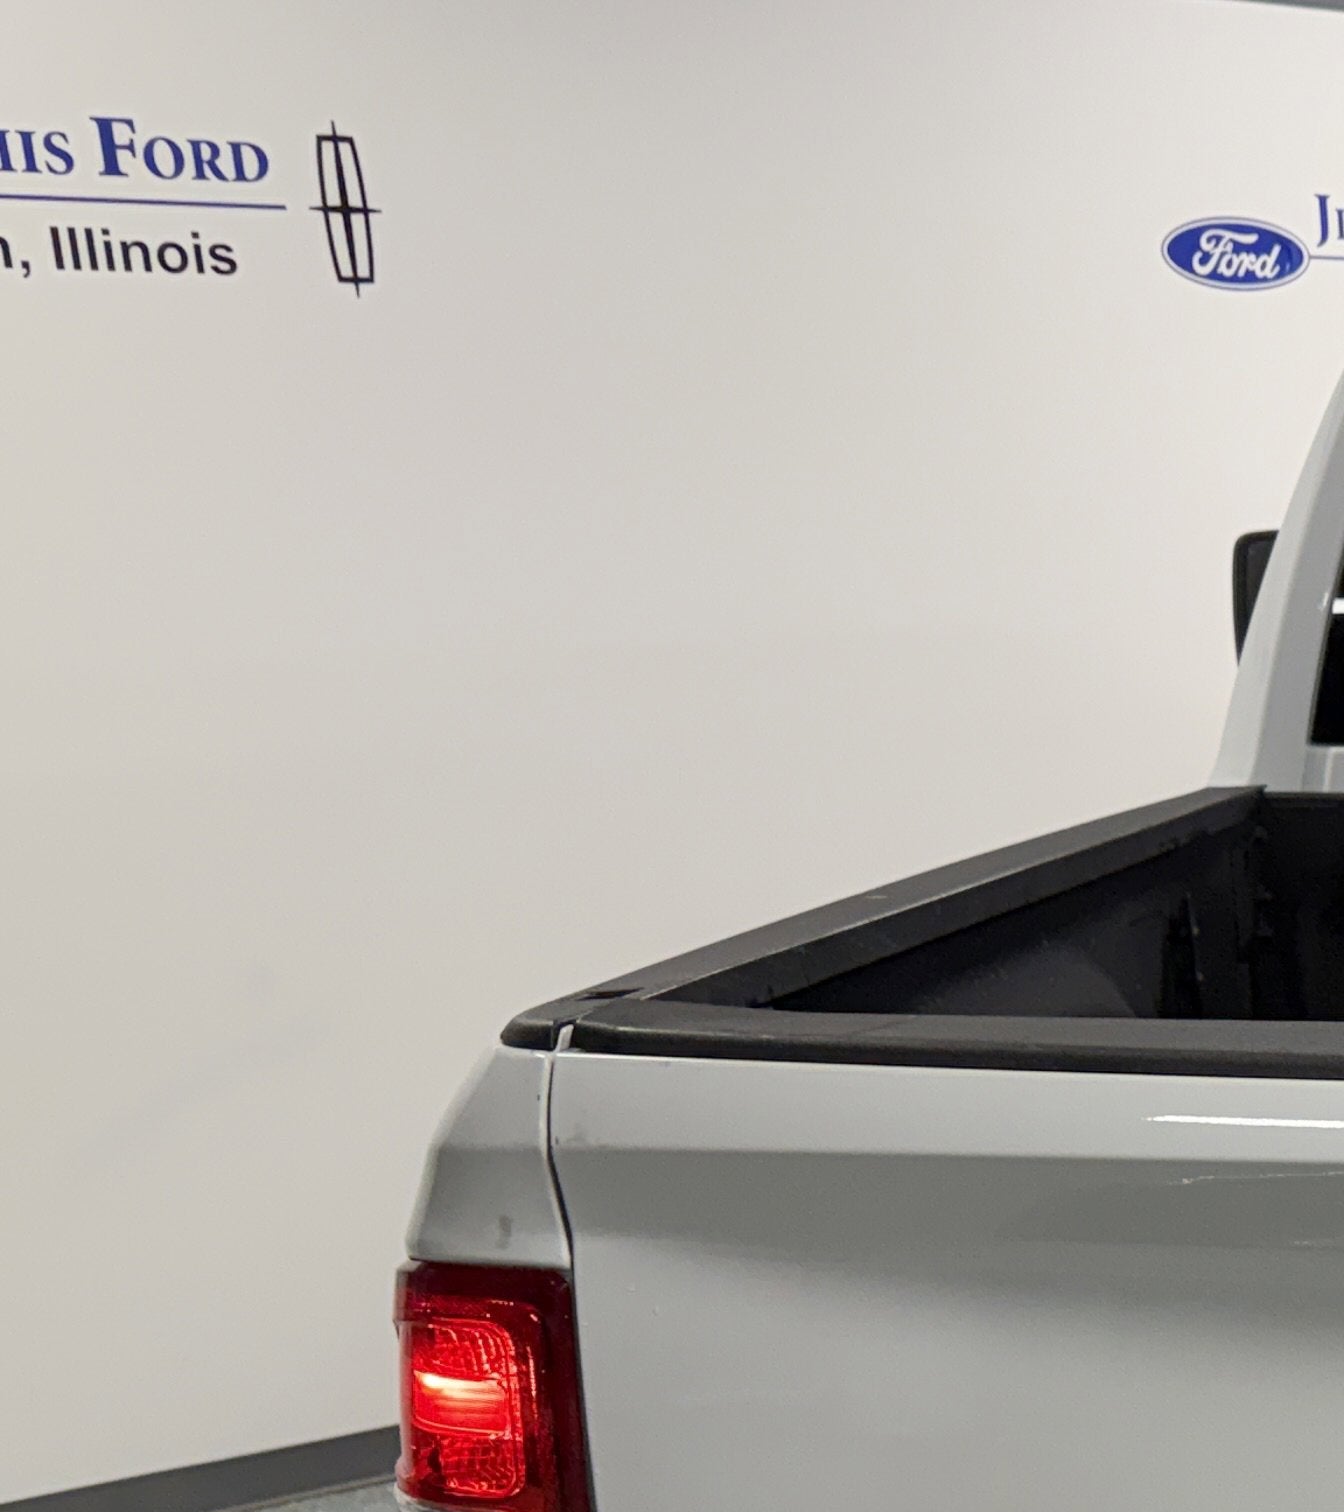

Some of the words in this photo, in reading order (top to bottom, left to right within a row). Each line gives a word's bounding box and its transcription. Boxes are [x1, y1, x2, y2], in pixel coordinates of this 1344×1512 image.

[90, 116, 270, 182] FORD
[49, 226, 238, 275] Illinois
[1191, 228, 1281, 280] Ford
